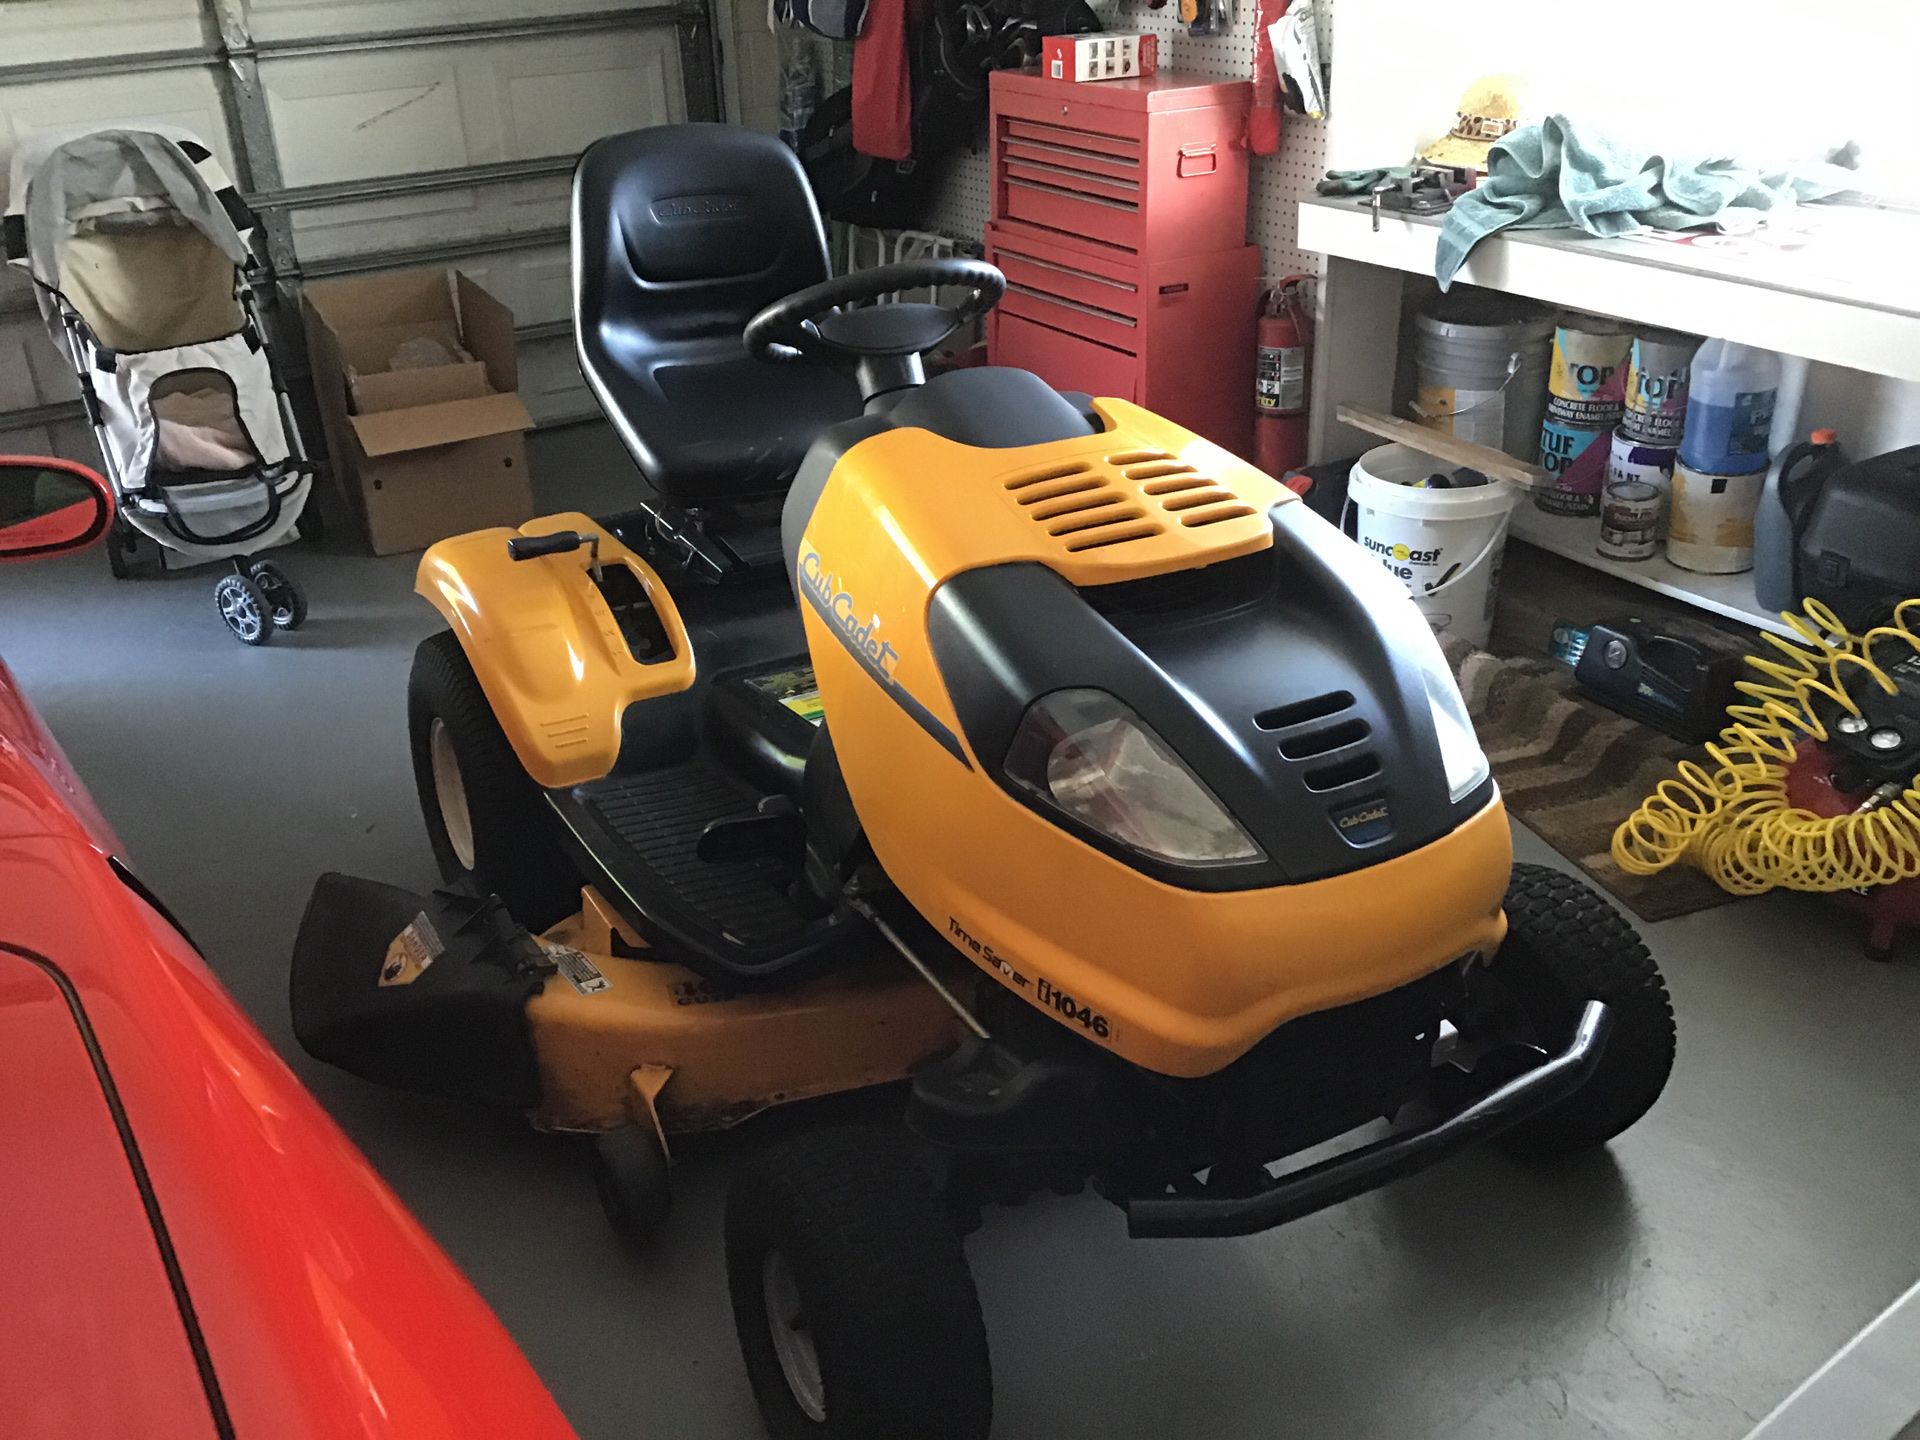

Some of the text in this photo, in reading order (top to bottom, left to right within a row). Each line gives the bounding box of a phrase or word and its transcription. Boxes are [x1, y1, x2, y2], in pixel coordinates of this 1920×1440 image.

[802, 552, 899, 680] Cub Cadet
[949, 916, 981, 954] Time
